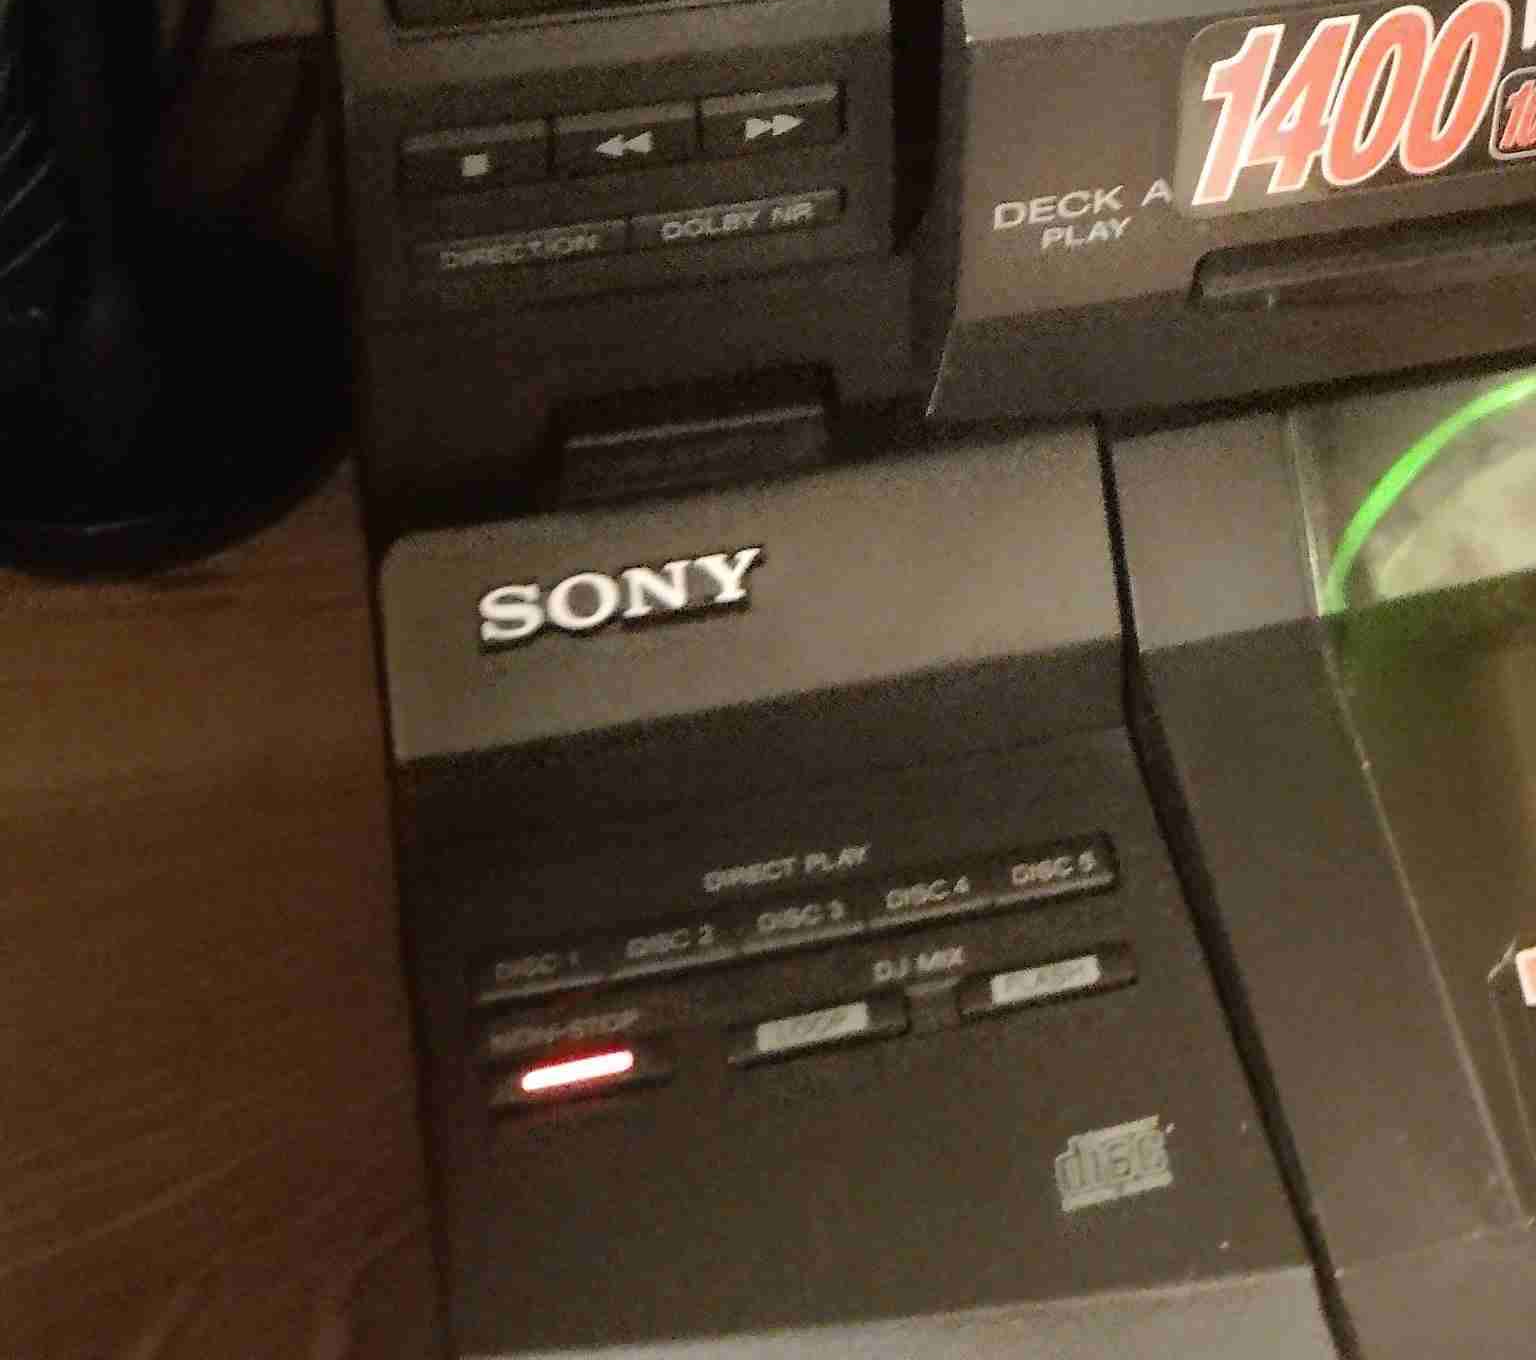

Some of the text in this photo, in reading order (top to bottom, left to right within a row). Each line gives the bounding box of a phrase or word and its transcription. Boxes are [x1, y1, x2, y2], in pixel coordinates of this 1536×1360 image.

[660, 202, 813, 241] DOLBY NR
[993, 178, 1173, 232] DECK A
[1041, 217, 1132, 250] PLAY
[479, 546, 762, 641] SONY
[704, 844, 869, 893] DIRECT PLAY
[1011, 860, 1071, 886] DISC
[884, 876, 971, 910] DISC 4
[756, 901, 844, 932] DISC 3
[626, 925, 714, 959] DISC 2
[495, 957, 563, 982] DISC
[873, 948, 966, 981] DJ MIX
